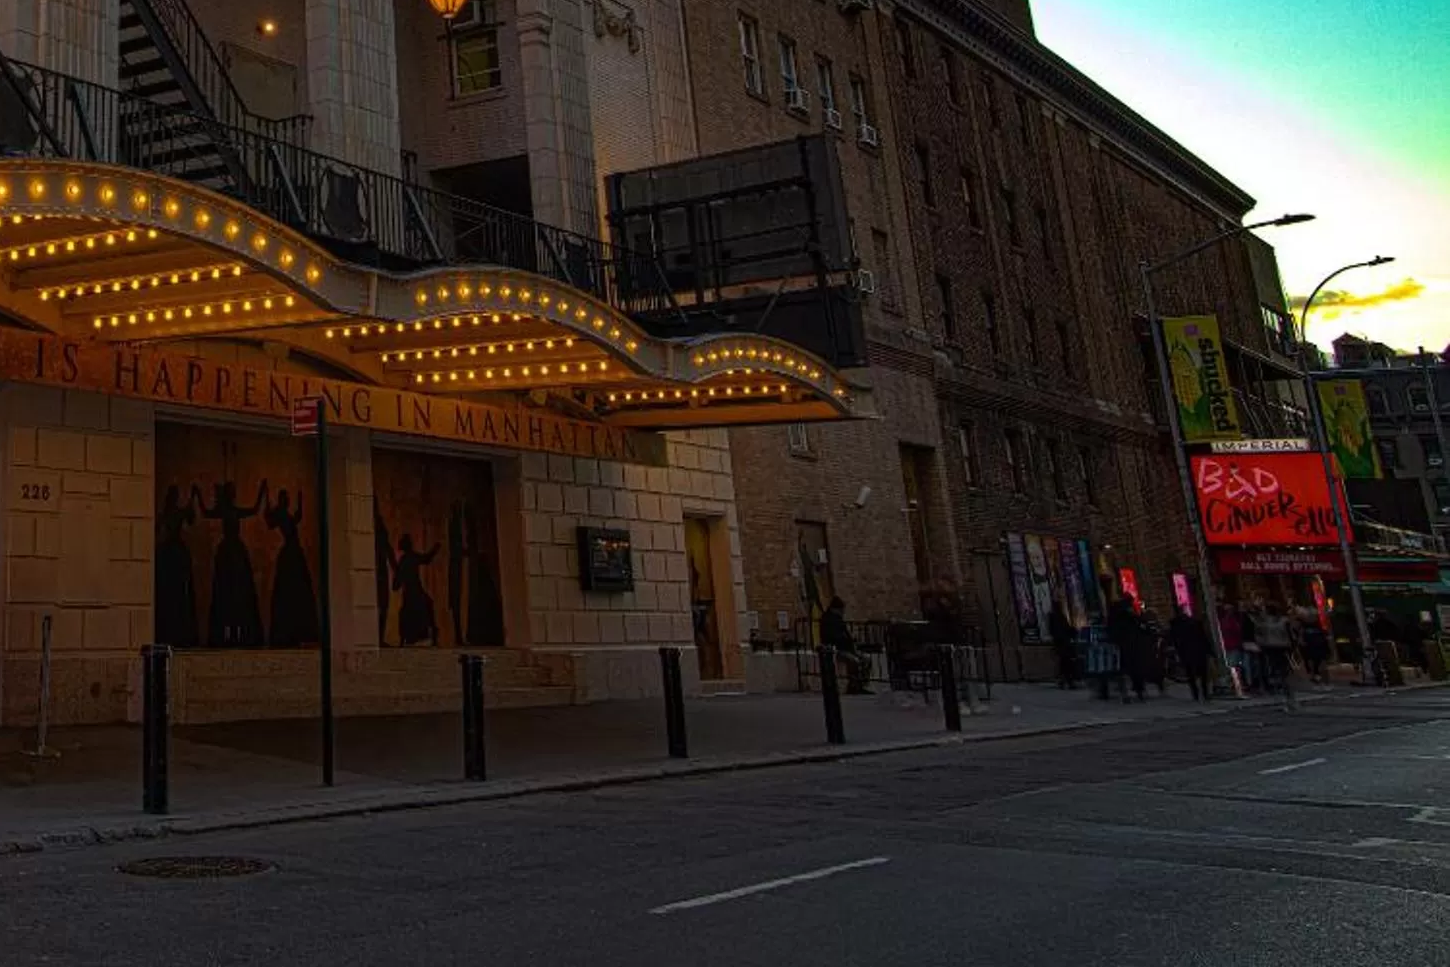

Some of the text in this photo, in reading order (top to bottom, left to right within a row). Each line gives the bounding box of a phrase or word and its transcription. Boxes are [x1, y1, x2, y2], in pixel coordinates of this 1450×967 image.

[34, 337, 79, 383] IS
[395, 394, 431, 430] IN
[454, 400, 637, 460] MANHATTAN
[1198, 337, 1237, 432] shucked
[1198, 458, 1280, 504] BAD
[1215, 441, 1306, 452] IMPERIAL
